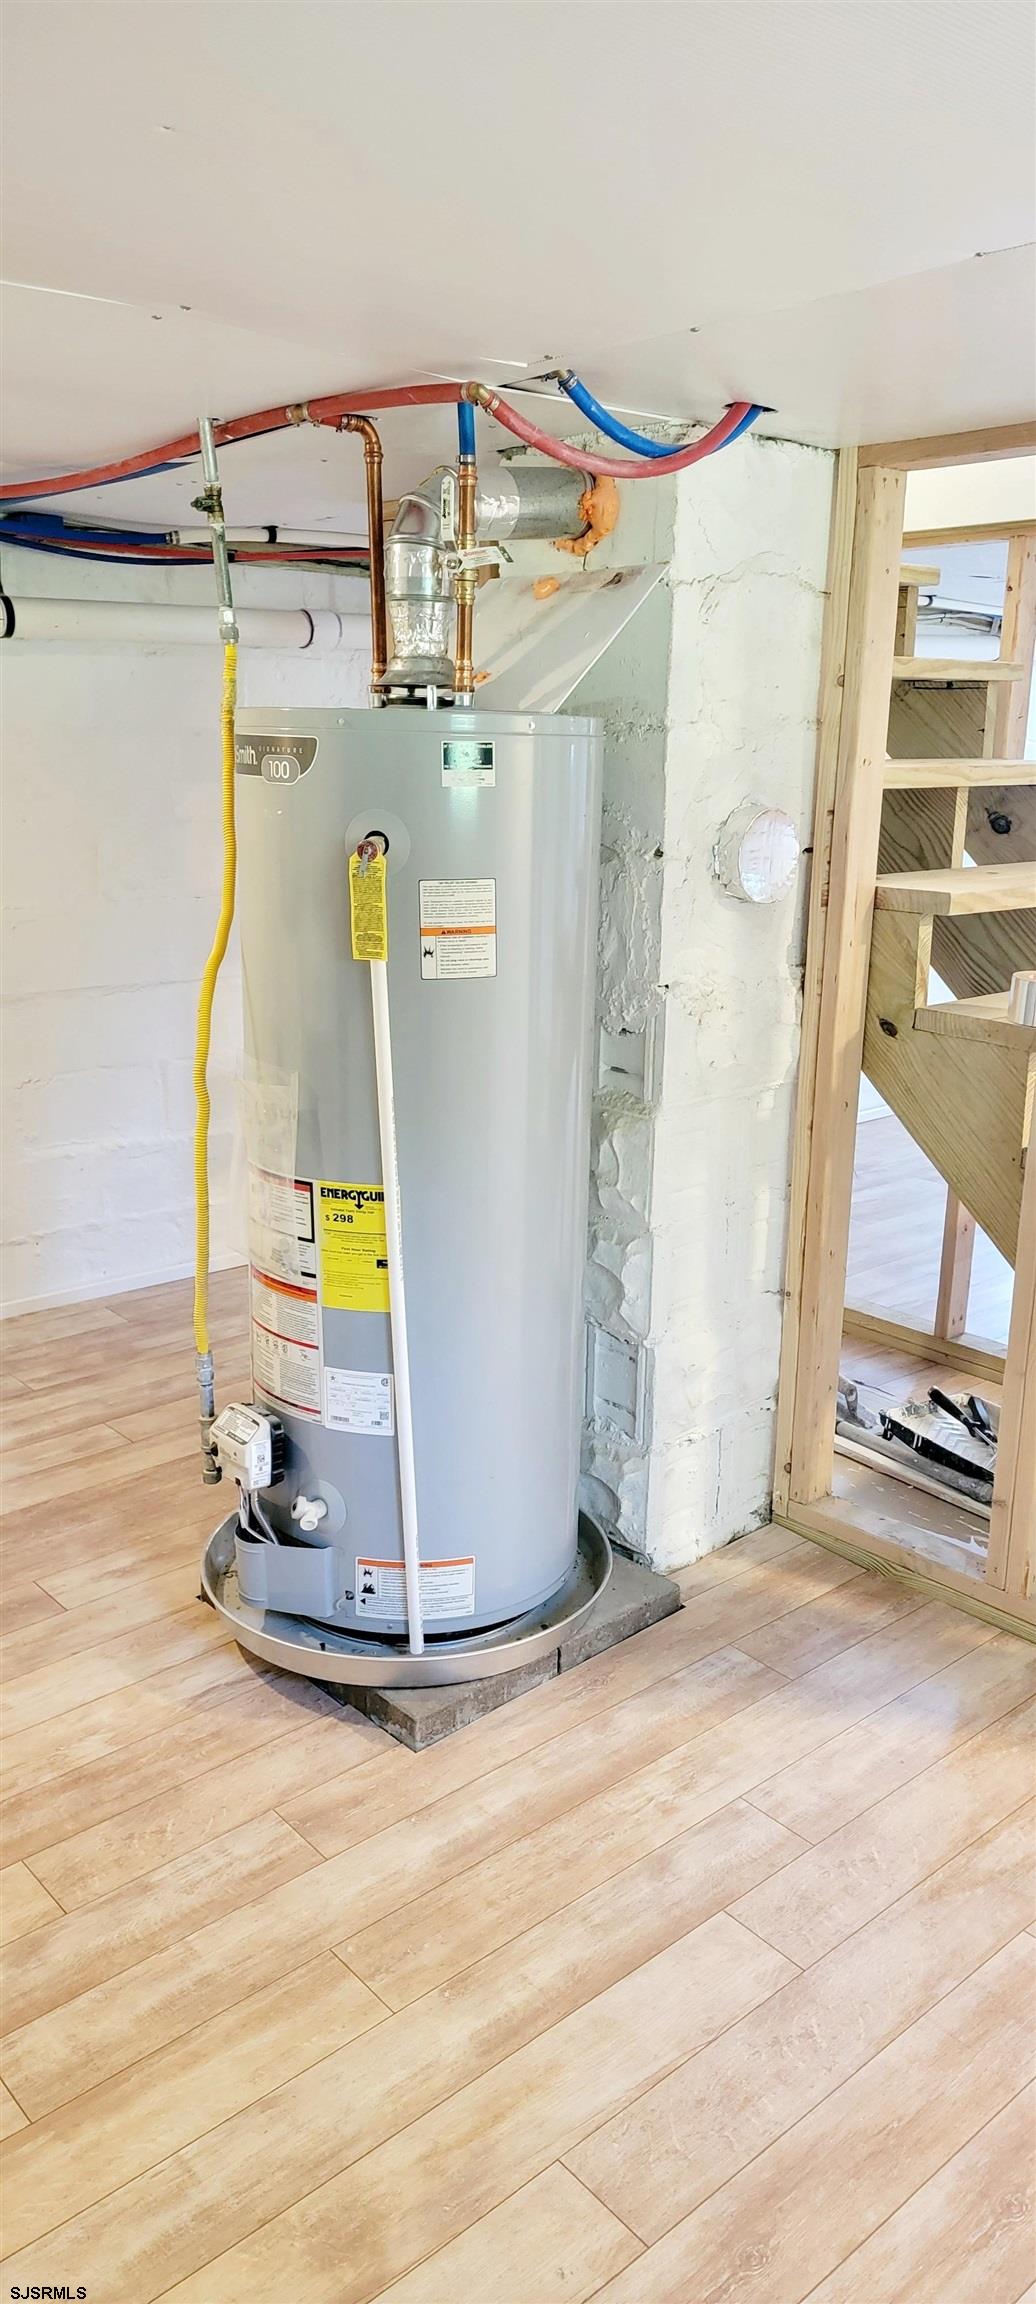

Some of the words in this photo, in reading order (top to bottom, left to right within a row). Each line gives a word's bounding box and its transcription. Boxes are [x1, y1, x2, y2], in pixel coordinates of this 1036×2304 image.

[268, 760, 290, 779] 100
[320, 1187, 384, 1202] ENERGYGUI
[325, 1214, 330, 1222] $
[333, 1214, 353, 1223] 298
